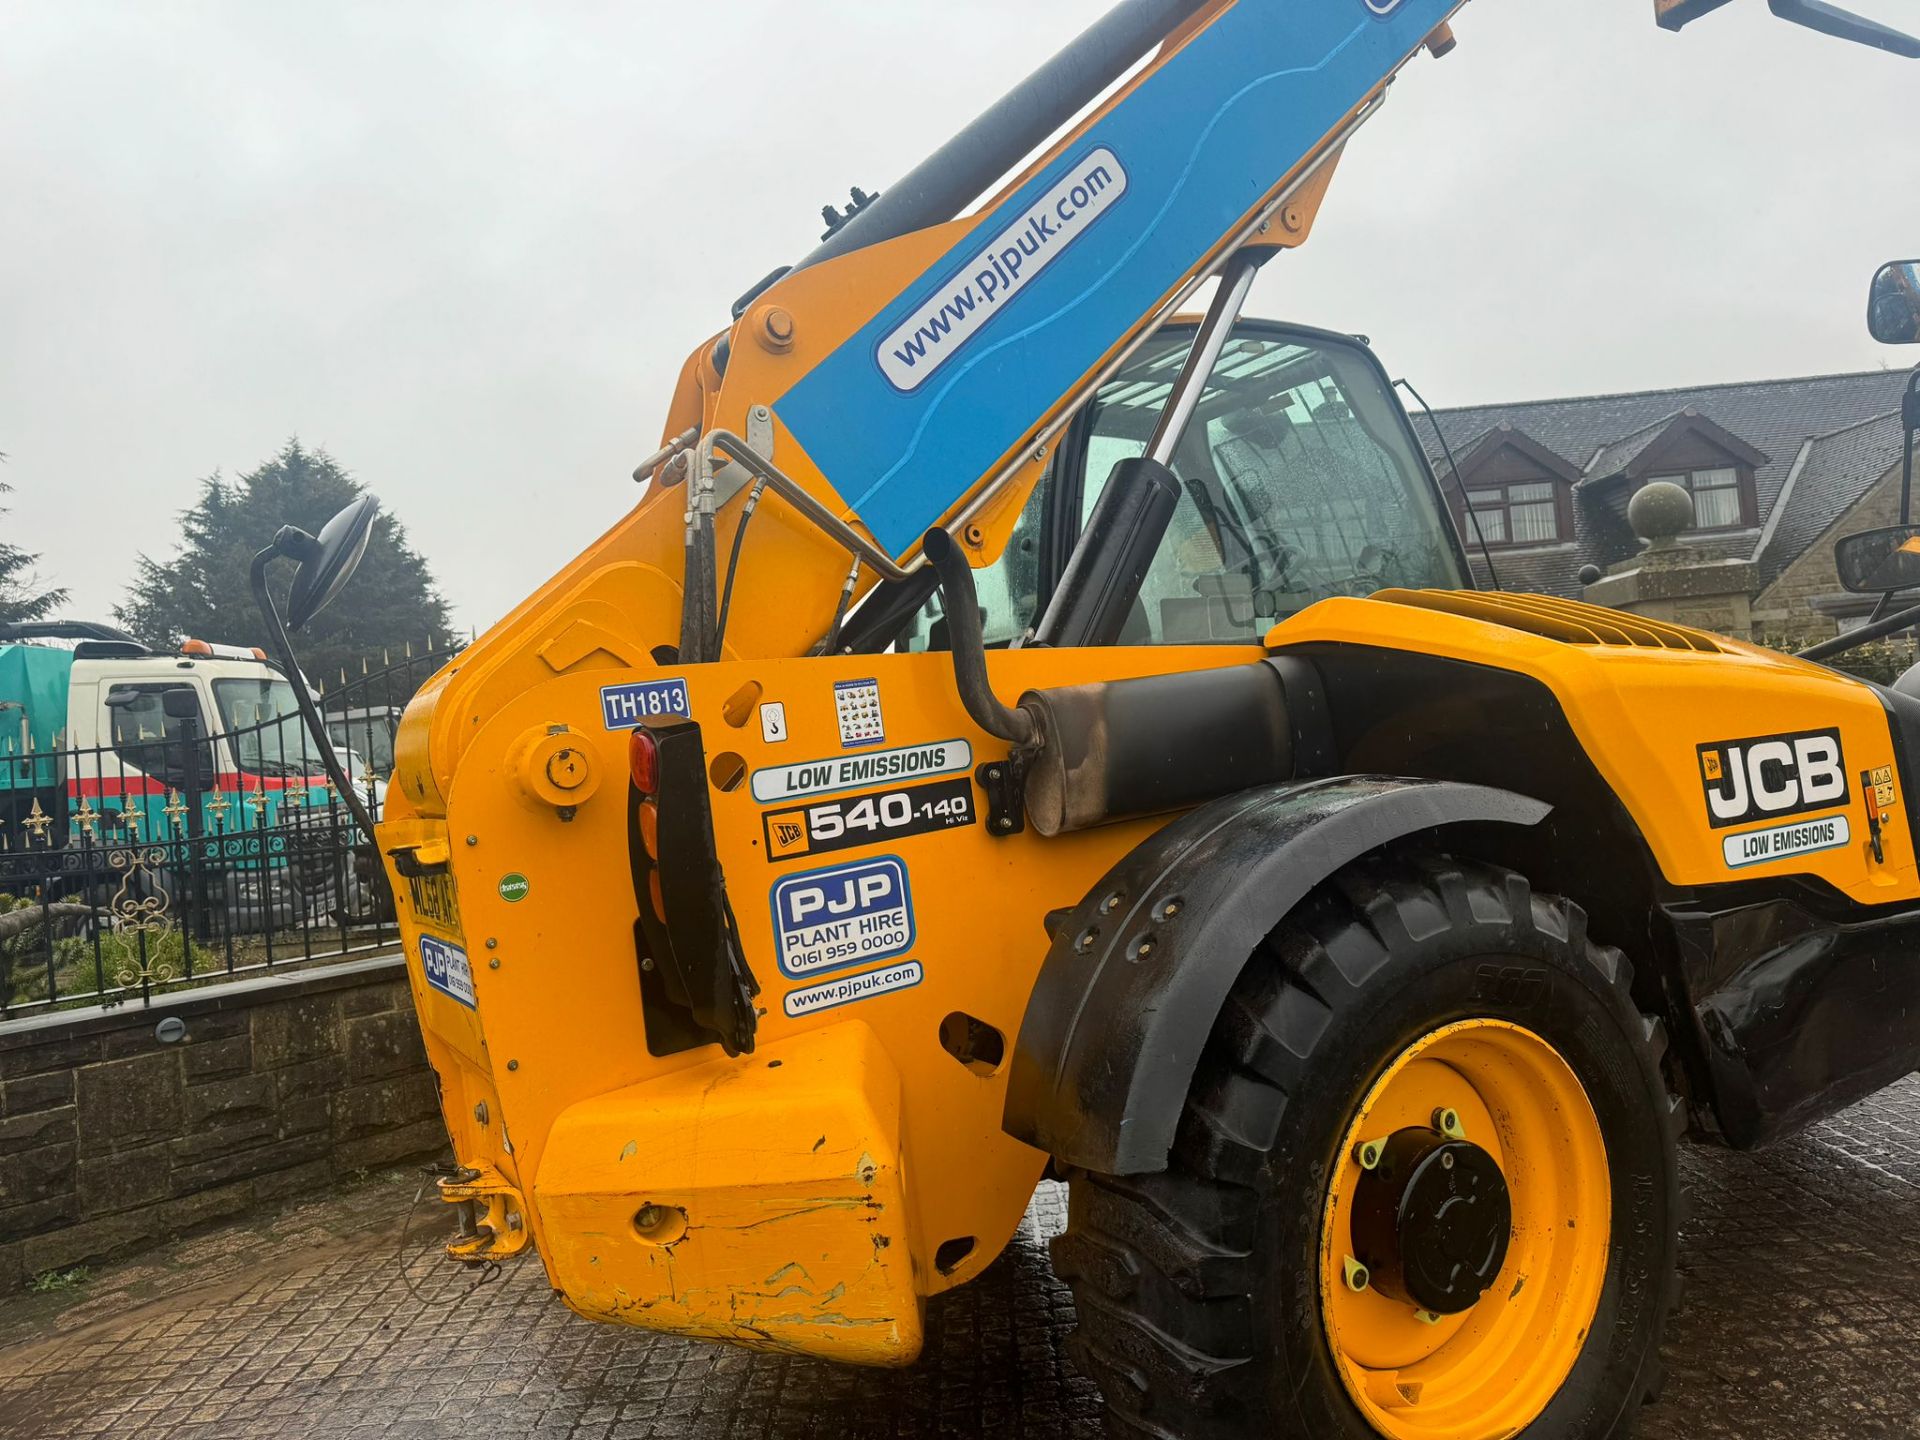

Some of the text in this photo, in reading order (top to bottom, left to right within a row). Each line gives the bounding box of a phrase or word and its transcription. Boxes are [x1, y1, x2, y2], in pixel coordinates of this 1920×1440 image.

[893, 165, 1112, 368] www.pjpuk.com
[606, 688, 684, 719] TH1813
[786, 748, 946, 791] LOW EMISSIONS
[1708, 736, 1845, 819] JCB
[778, 824, 802, 846] JCB
[1743, 823, 1835, 858] LOW EMISSIONS
[789, 873, 892, 923] PJP
[786, 911, 904, 952] PLANT HIRE
[791, 930, 905, 968] 0161 959 0000
[425, 947, 445, 978] PJP
[793, 968, 915, 1008] www.pjpuk.com
